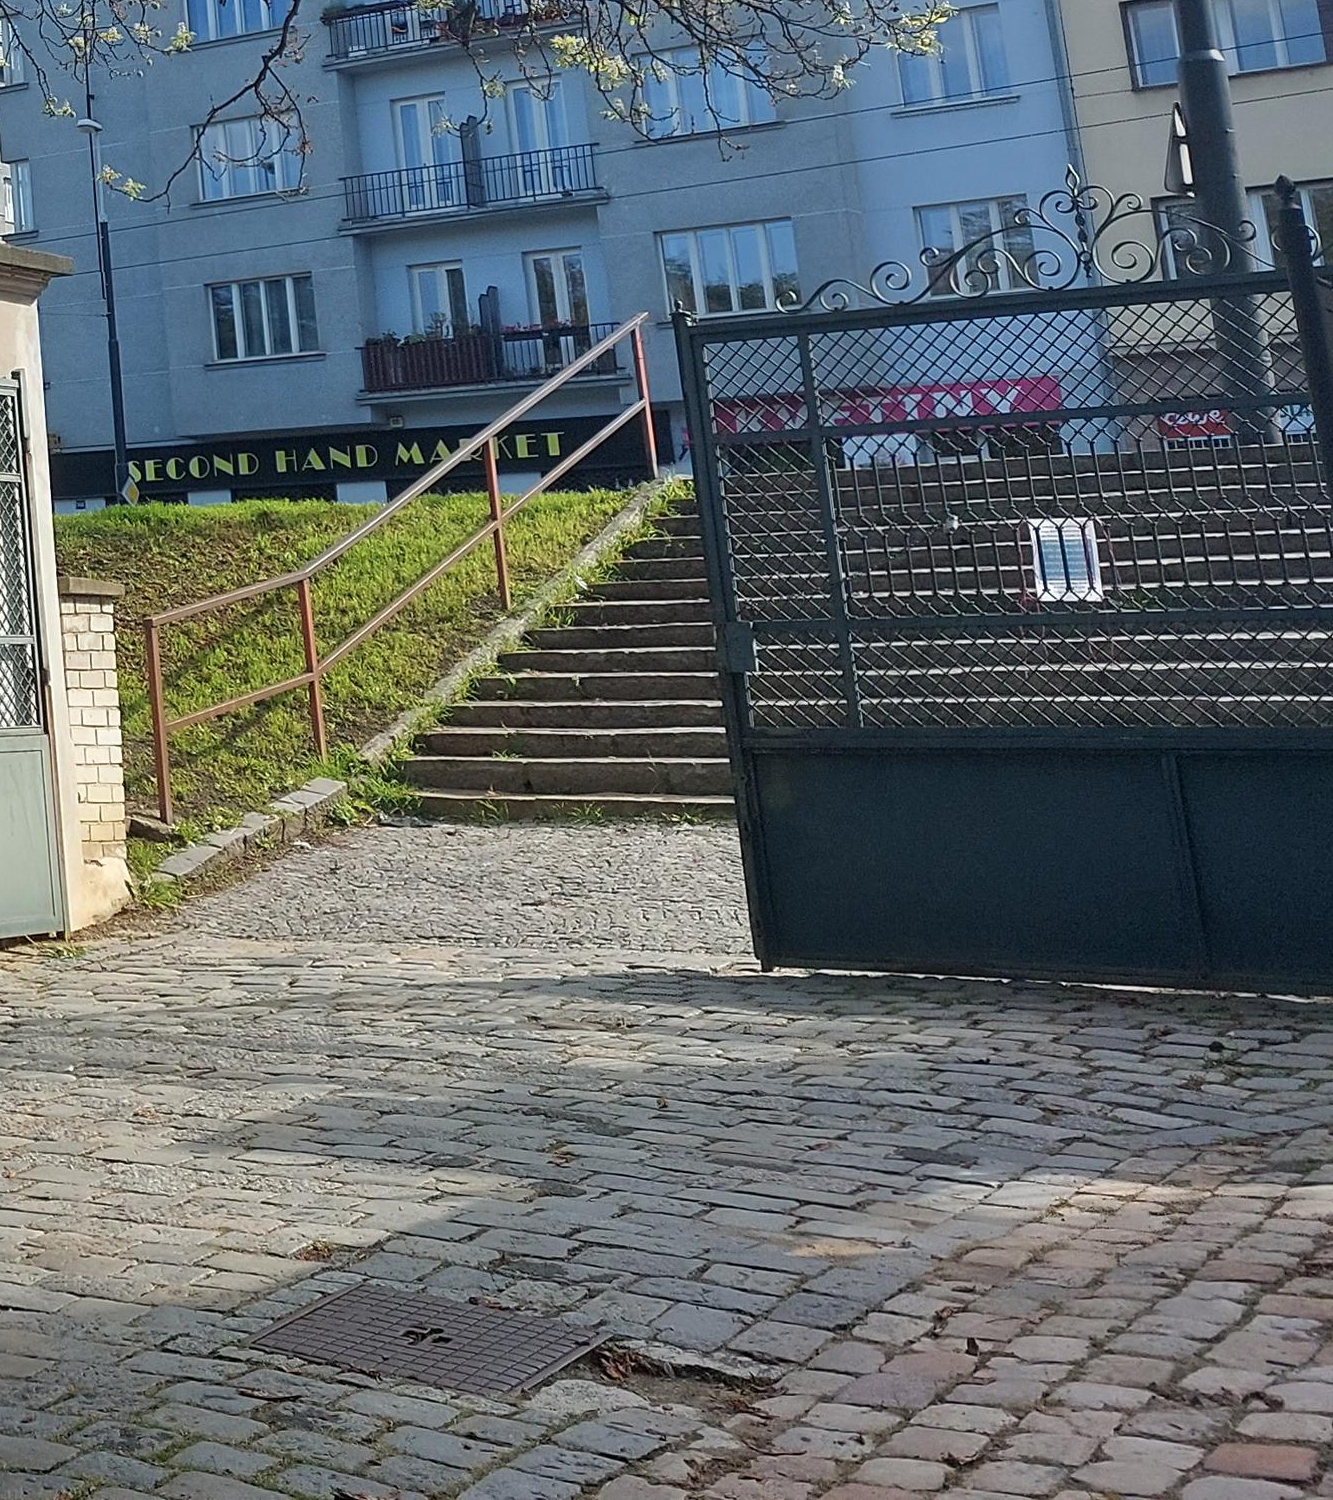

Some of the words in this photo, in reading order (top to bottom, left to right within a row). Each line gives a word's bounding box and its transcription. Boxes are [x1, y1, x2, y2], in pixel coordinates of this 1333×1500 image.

[127, 452, 260, 483] SECOND
[275, 444, 378, 473] HAND
[395, 431, 565, 467] MARKET
